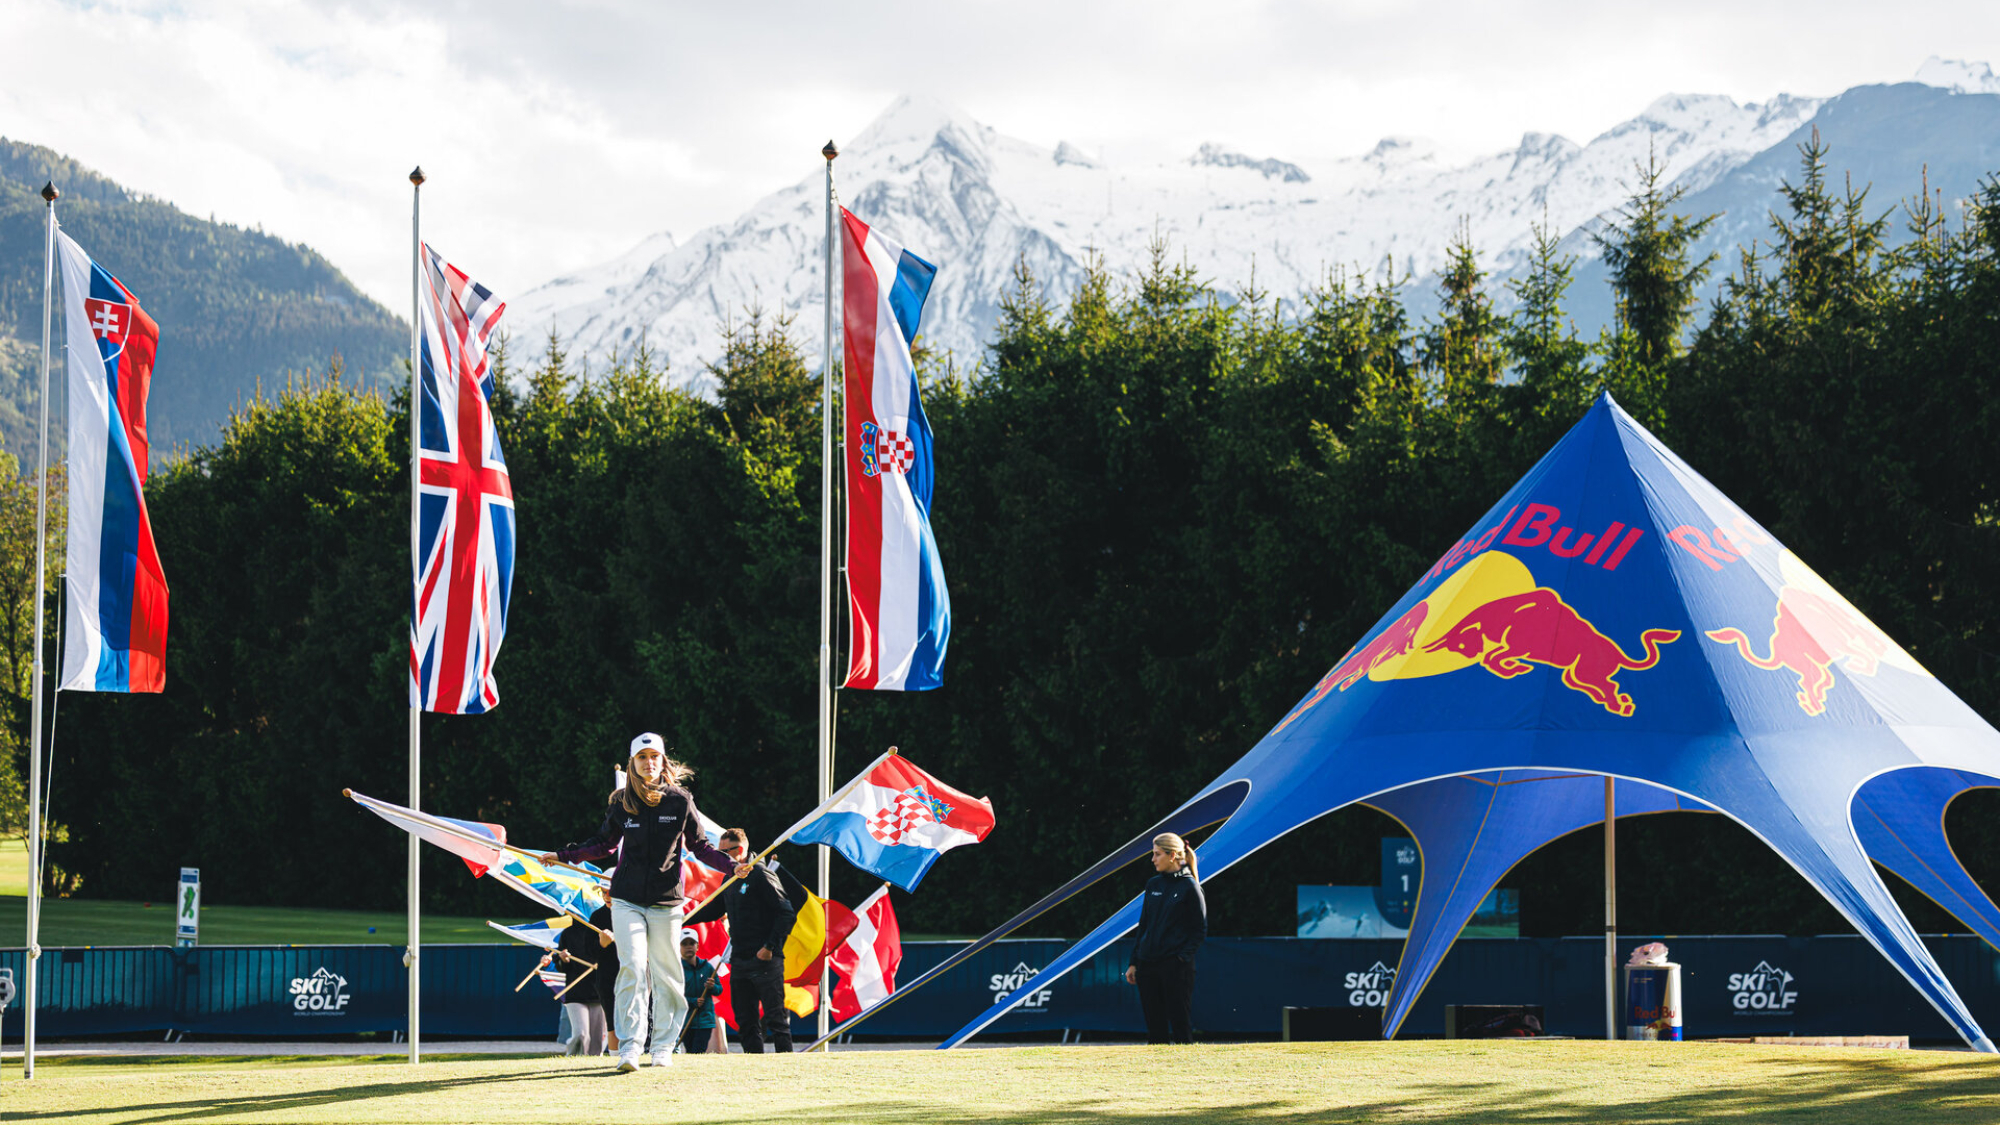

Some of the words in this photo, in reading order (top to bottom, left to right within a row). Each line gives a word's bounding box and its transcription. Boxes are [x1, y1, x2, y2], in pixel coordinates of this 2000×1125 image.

[1418, 504, 1520, 587] Red
[1501, 503, 1644, 571] Bull
[1401, 875, 1409, 892] 1
[289, 978, 324, 994] SKI
[989, 974, 1024, 990] SKI
[1344, 972, 1380, 989] SKI
[1727, 974, 1766, 991] SKI
[294, 995, 350, 1010] GOLF
[994, 990, 1052, 1007] GLF
[1349, 990, 1389, 1007] GOL
[1733, 992, 1798, 1009] GOLF
[1634, 1006, 1659, 1019] Red
